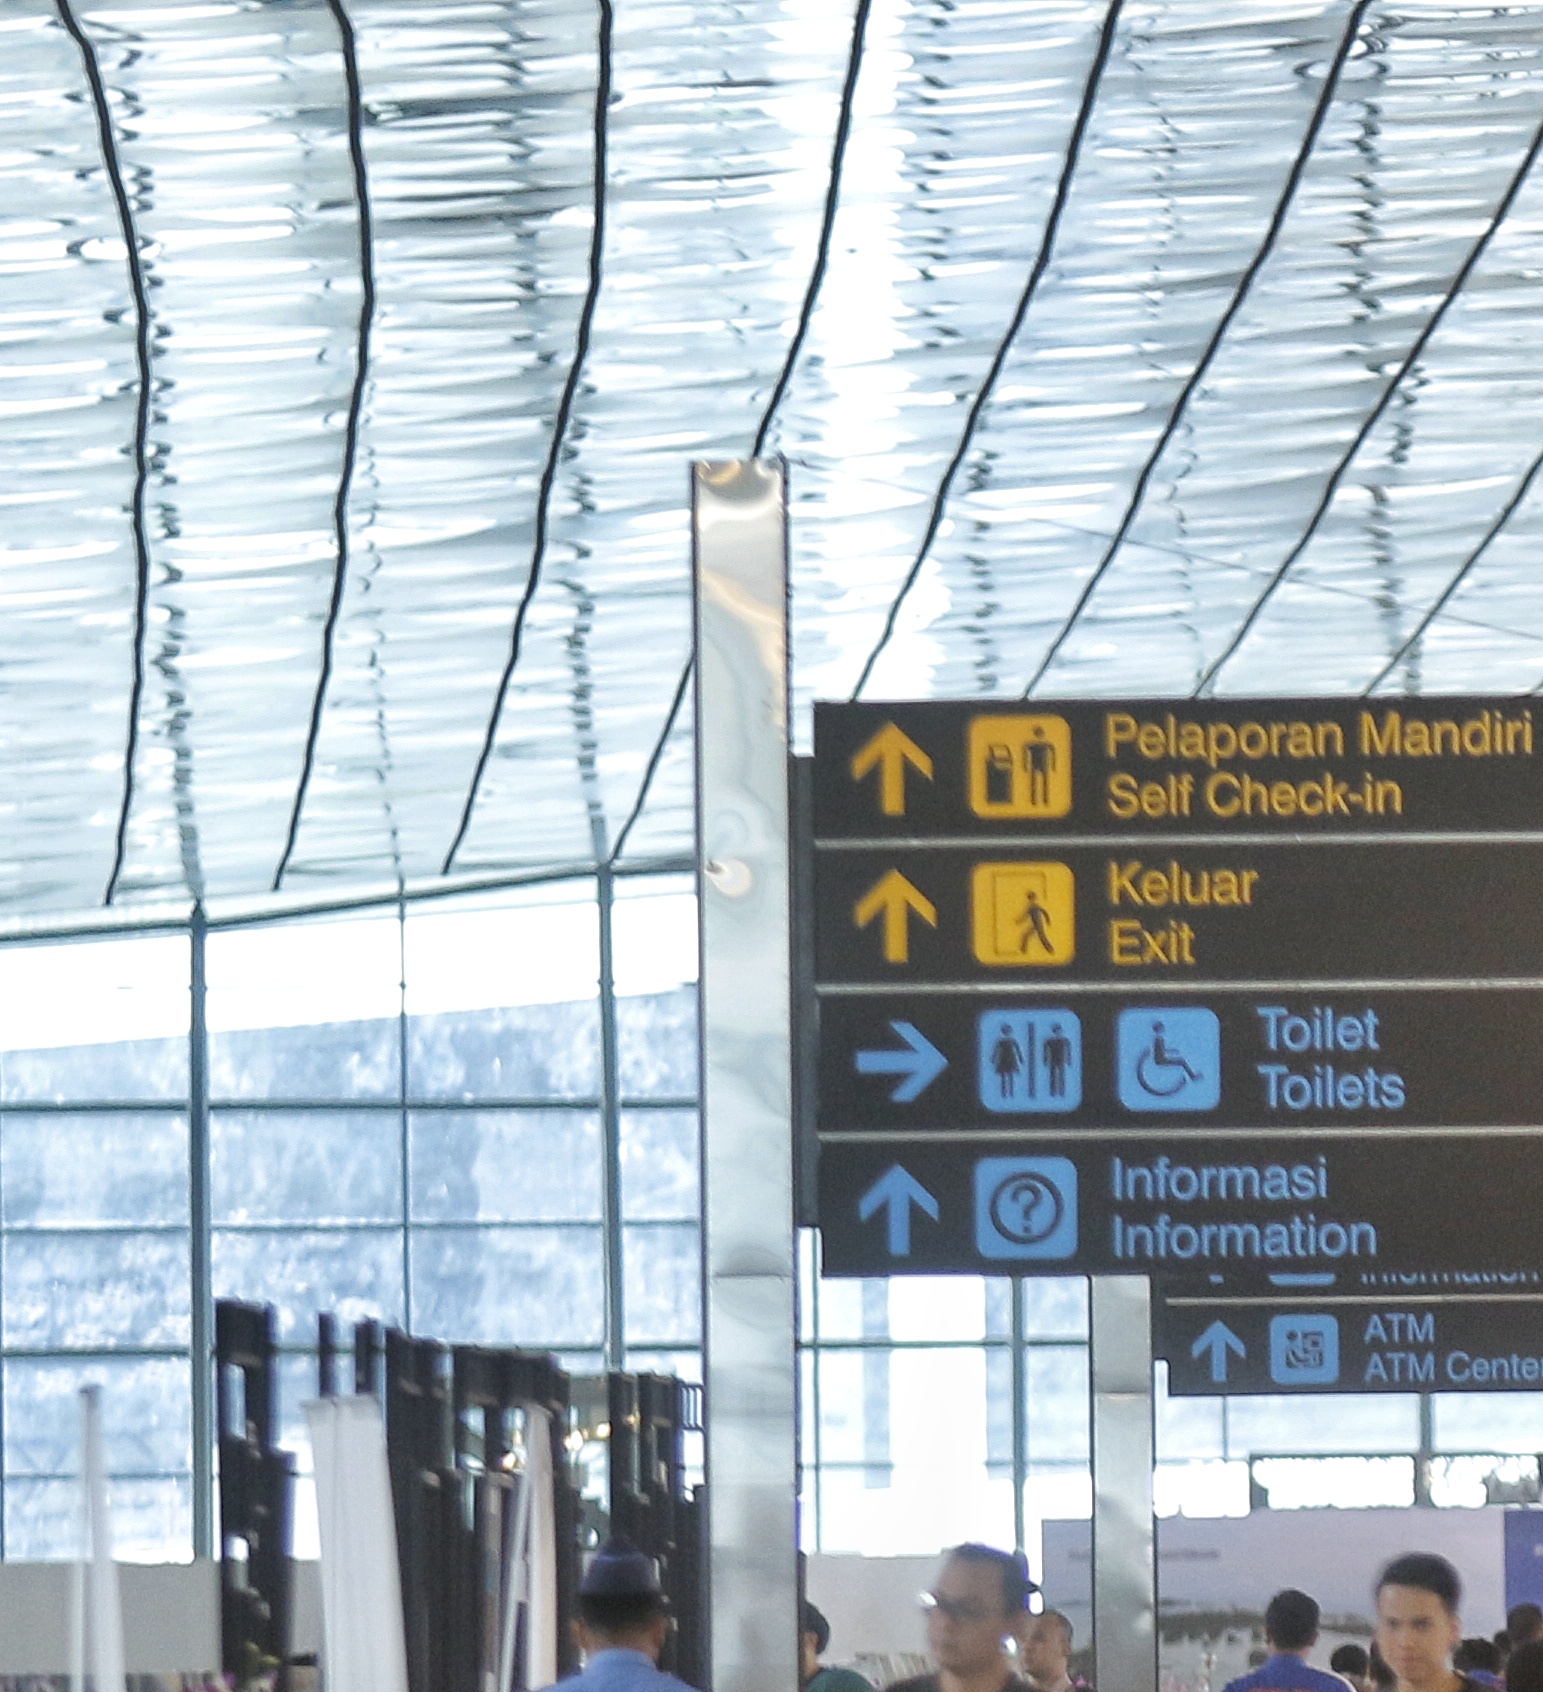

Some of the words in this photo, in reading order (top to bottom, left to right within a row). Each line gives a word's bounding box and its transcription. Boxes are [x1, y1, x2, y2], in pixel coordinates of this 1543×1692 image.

[1107, 714, 1343, 766] Pelaporan
[1361, 711, 1532, 756] Mandiri
[1109, 773, 1193, 817] Self
[1206, 772, 1402, 817] Check-in
[1109, 861, 1258, 906] Keluar
[1110, 920, 1195, 964] Exit
[1257, 1007, 1379, 1051] Toilet
[1257, 1065, 1405, 1109] Toilets
[1113, 1156, 1327, 1201] Informasi
[1113, 1214, 1376, 1258] Information
[1364, 1313, 1434, 1343] ATM
[1365, 1352, 1435, 1382] ATM
